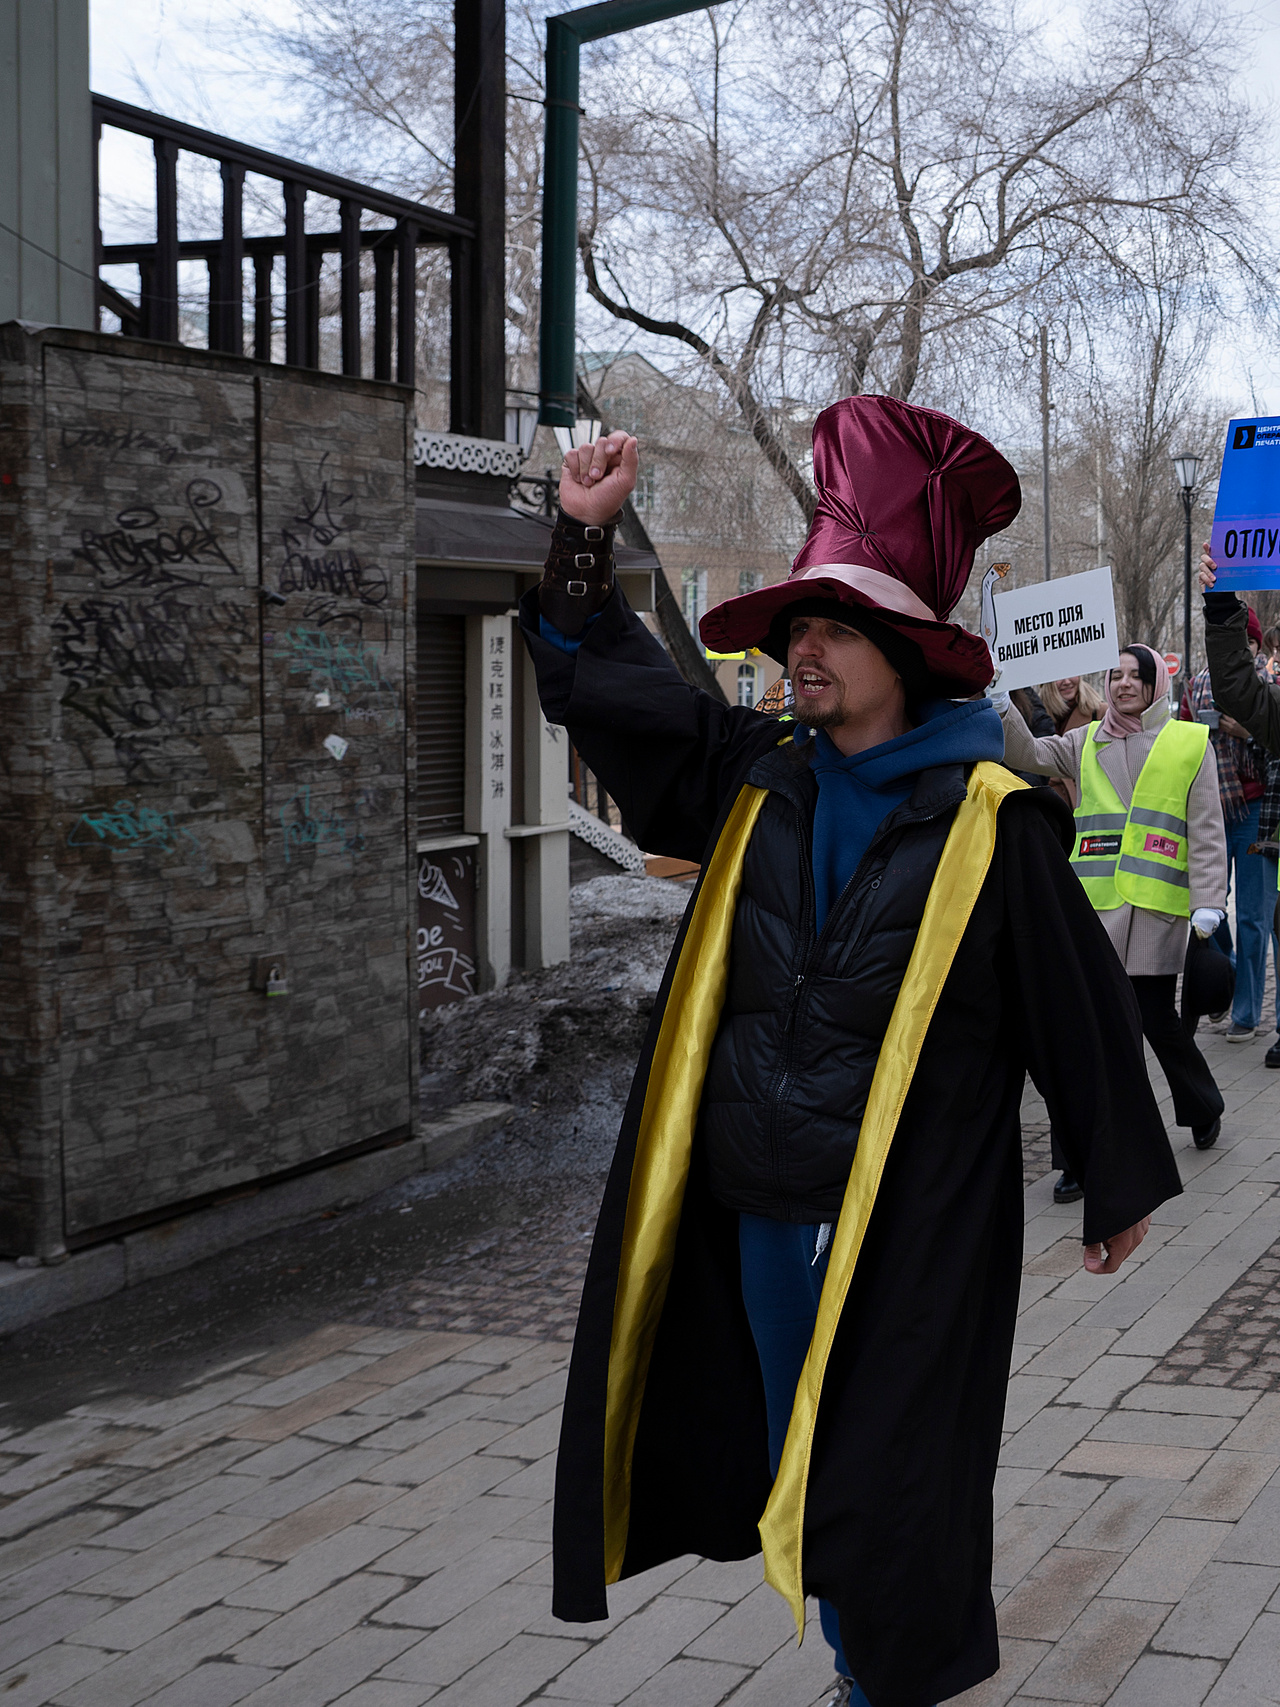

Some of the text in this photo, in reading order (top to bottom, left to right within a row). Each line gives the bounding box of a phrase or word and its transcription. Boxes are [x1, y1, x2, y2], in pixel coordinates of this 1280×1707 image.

[1014, 604, 1084, 636] МЕСТО ДЛЯ
[998, 623, 1105, 662] ВАШЕЙ РЕКЛАМЫ
